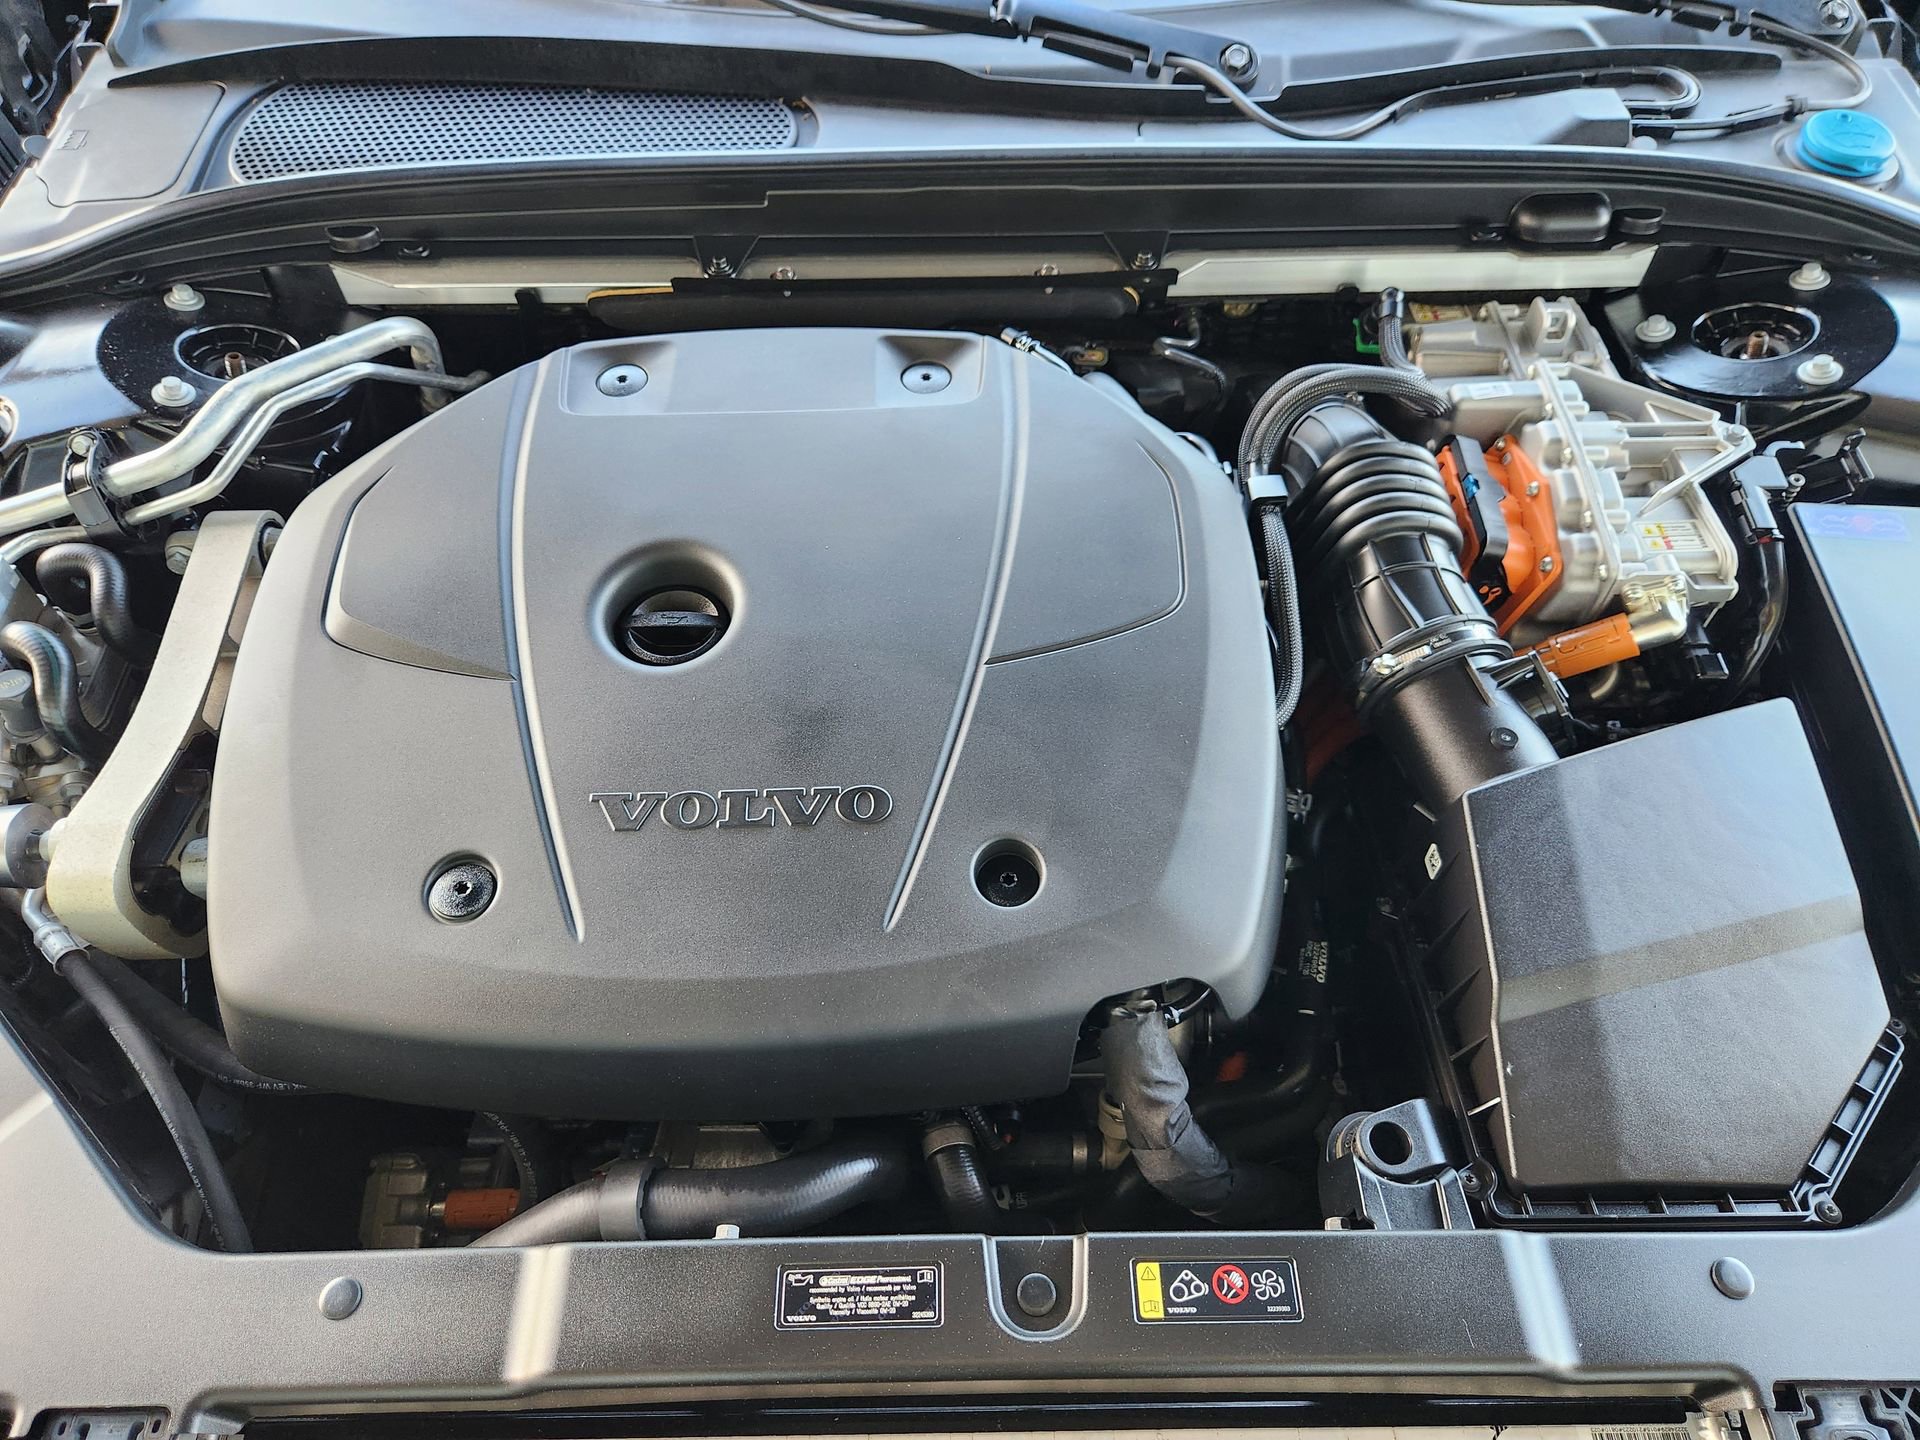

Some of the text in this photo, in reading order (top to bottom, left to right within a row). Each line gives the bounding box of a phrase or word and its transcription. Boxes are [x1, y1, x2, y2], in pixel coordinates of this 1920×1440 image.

[589, 784, 893, 831] VOLVO
[1316, 941, 1328, 983] VOLVO
[839, 1286, 846, 1294] by
[1166, 1306, 1198, 1314] VOLVO
